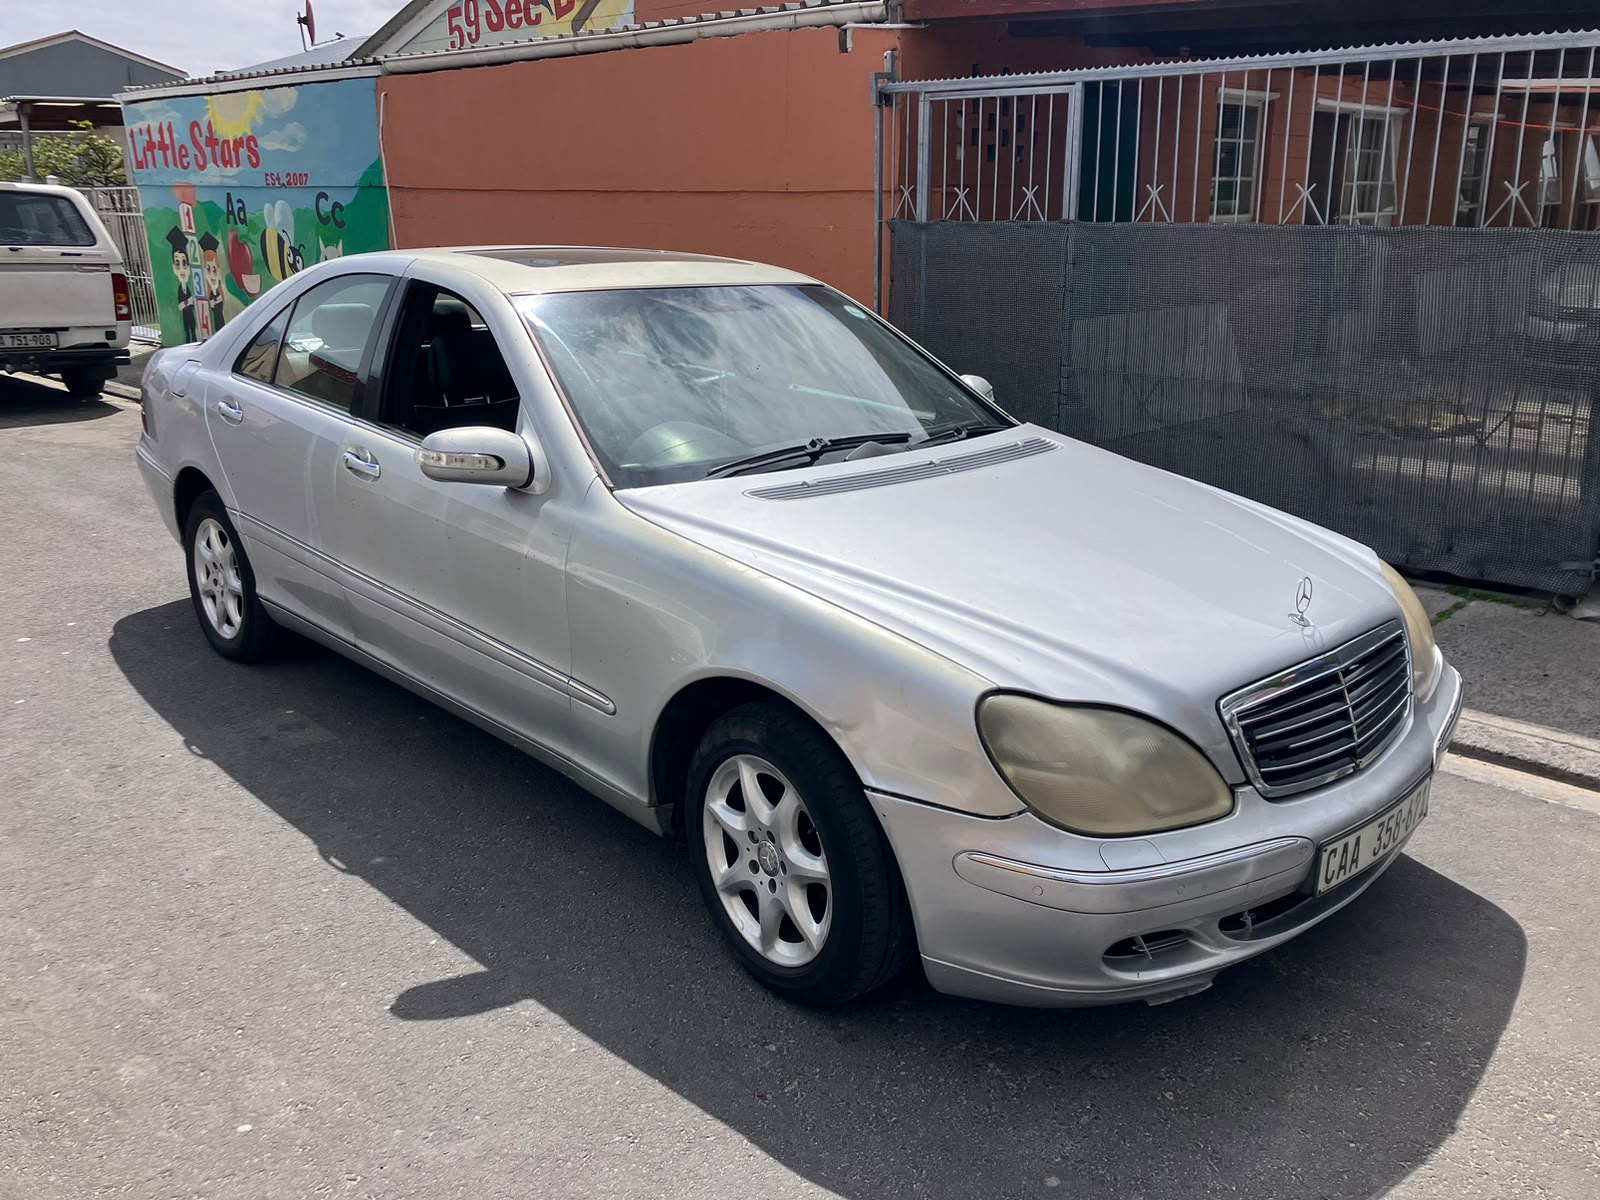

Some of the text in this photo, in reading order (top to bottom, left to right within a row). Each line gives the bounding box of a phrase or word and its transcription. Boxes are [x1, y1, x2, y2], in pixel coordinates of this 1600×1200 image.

[486, 0, 541, 32] Sec
[130, 119, 260, 171] Little Stars
[285, 172, 309, 186] 2007
[185, 206, 194, 231] 1
[225, 192, 248, 227] Aa
[315, 192, 346, 229] Cc
[190, 239, 200, 259] 2
[193, 271, 203, 296] 3
[200, 303, 211, 336] 4
[9, 334, 52, 347] 751-908
[1324, 835, 1362, 885] CAA
